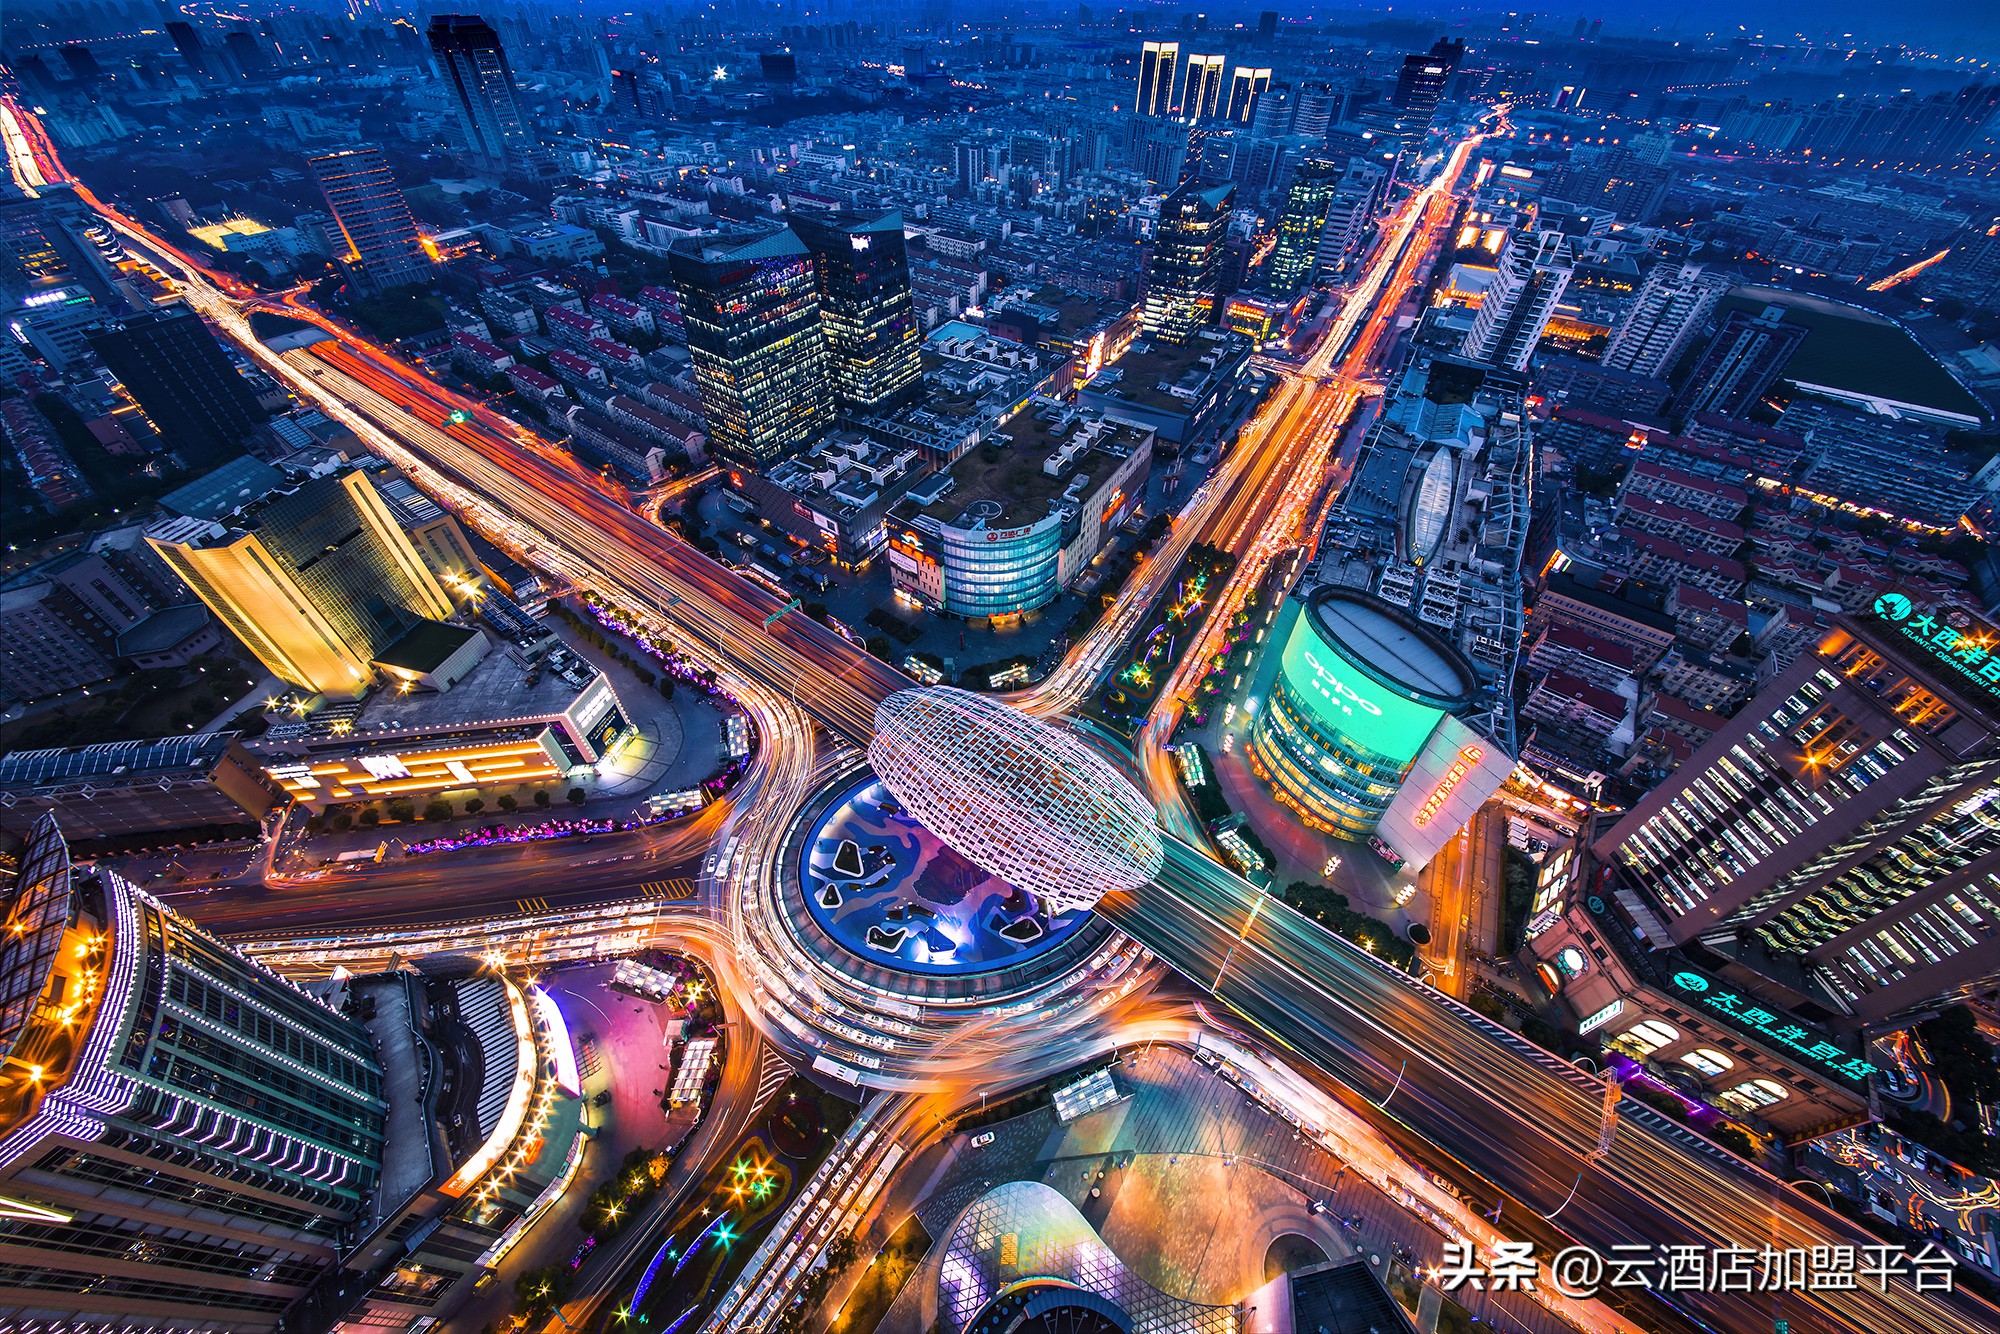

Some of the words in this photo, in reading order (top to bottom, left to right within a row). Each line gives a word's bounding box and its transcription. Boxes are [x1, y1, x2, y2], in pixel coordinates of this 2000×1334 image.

[1900, 626, 1937, 653] ATLANTIC
[1703, 998, 1754, 1025] ATLANTIC
[1754, 1024, 1824, 1061] DEPARTMENT
[1824, 1060, 1867, 1081] STORE
[1710, 991, 1878, 1077] 大西洋百货
